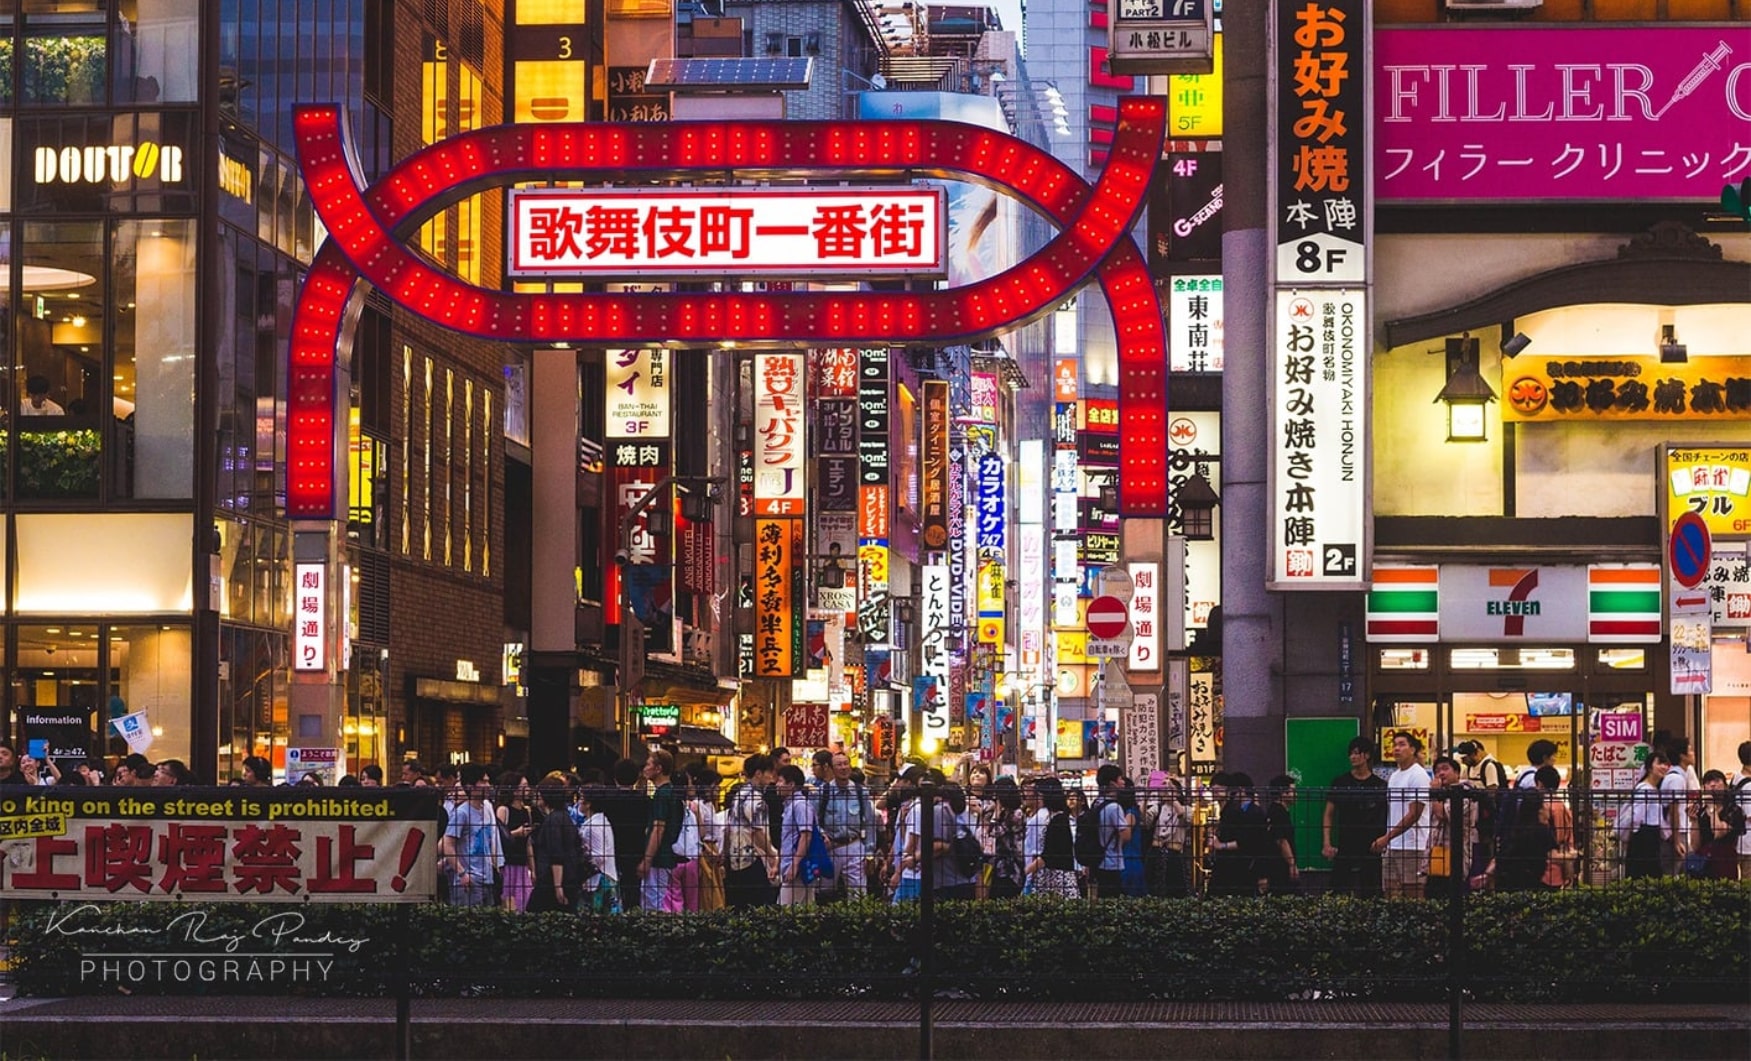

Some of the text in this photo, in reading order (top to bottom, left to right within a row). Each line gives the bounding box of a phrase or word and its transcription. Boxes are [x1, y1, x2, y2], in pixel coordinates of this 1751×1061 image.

[1126, 6, 1158, 16] PART2
[558, 37, 572, 59] 3
[1130, 31, 1192, 48] 小松ビル
[1293, 2, 1349, 192] お好み焼
[1383, 64, 1660, 122] FILLER
[35, 142, 182, 184] DOUTOR
[1173, 159, 1197, 177] 4F
[1385, 145, 1534, 181] フィラー
[529, 204, 925, 260] 歌舞伎町一番街
[1295, 241, 1346, 273] 8F
[1341, 302, 1354, 482] OKONOMIYAKI HONJIN
[625, 421, 649, 433] 3F
[1284, 323, 1316, 547] お好み焼き本陣
[616, 445, 660, 466] 焼肉
[982, 459, 1001, 532] カラオケ
[767, 501, 792, 514] 4F
[981, 533, 1001, 545] 747
[1326, 549, 1354, 571] 2F
[302, 571, 319, 661] 劇場通り
[1135, 571, 1152, 661] 劇場通り
[26, 714, 82, 725] information
[1605, 720, 1637, 737] SIM
[1591, 745, 1627, 761] たばこ
[26, 797, 74, 819] king
[83, 801, 110, 815] on
[118, 798, 146, 815] the
[163, 798, 233, 816] street
[241, 798, 261, 816] is
[268, 798, 396, 821] prohibited.
